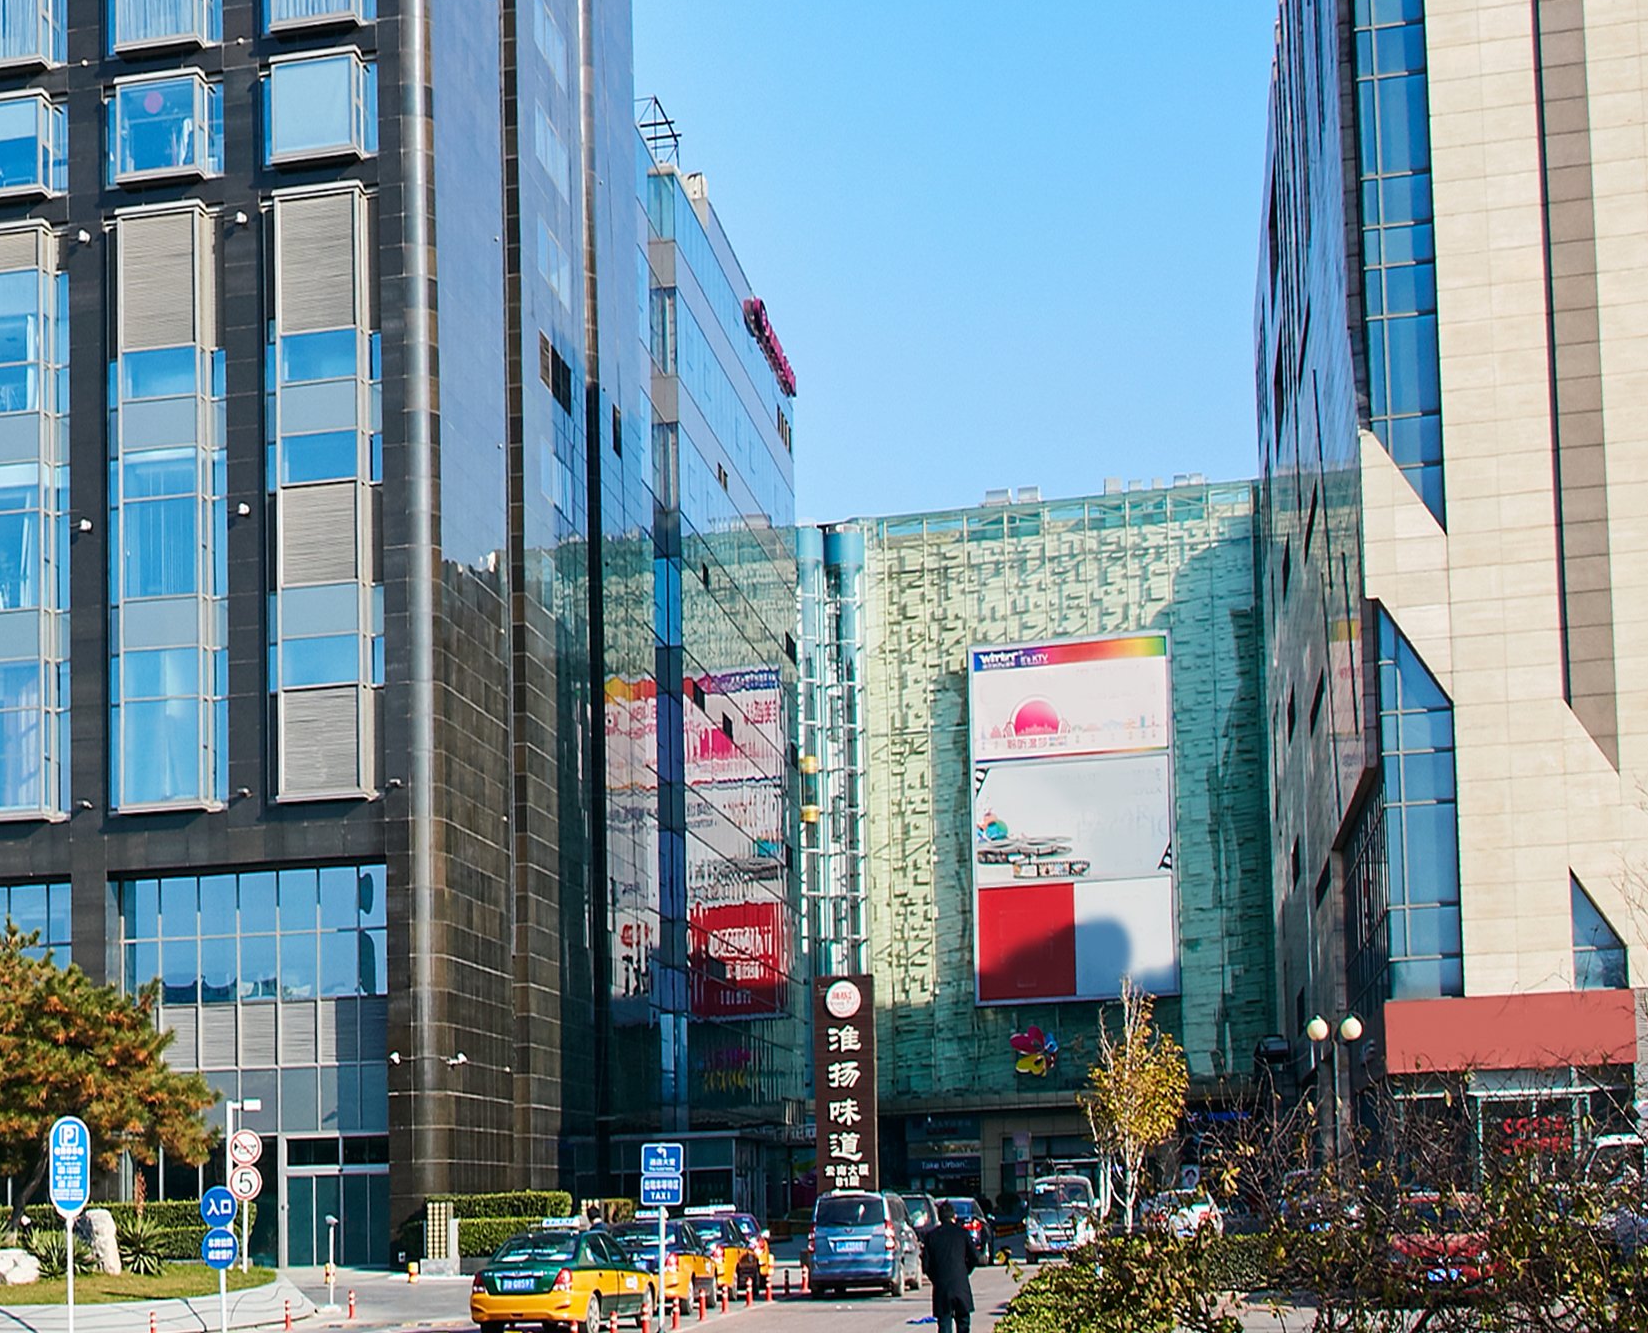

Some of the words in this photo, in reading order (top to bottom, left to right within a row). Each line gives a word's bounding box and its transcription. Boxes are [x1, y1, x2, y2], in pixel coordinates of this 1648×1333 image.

[828, 1026, 862, 1162] 淮扬味道
[239, 1171, 252, 1194] 5
[650, 1191, 671, 1200] TAXI
[206, 1198, 232, 1217] 入口
